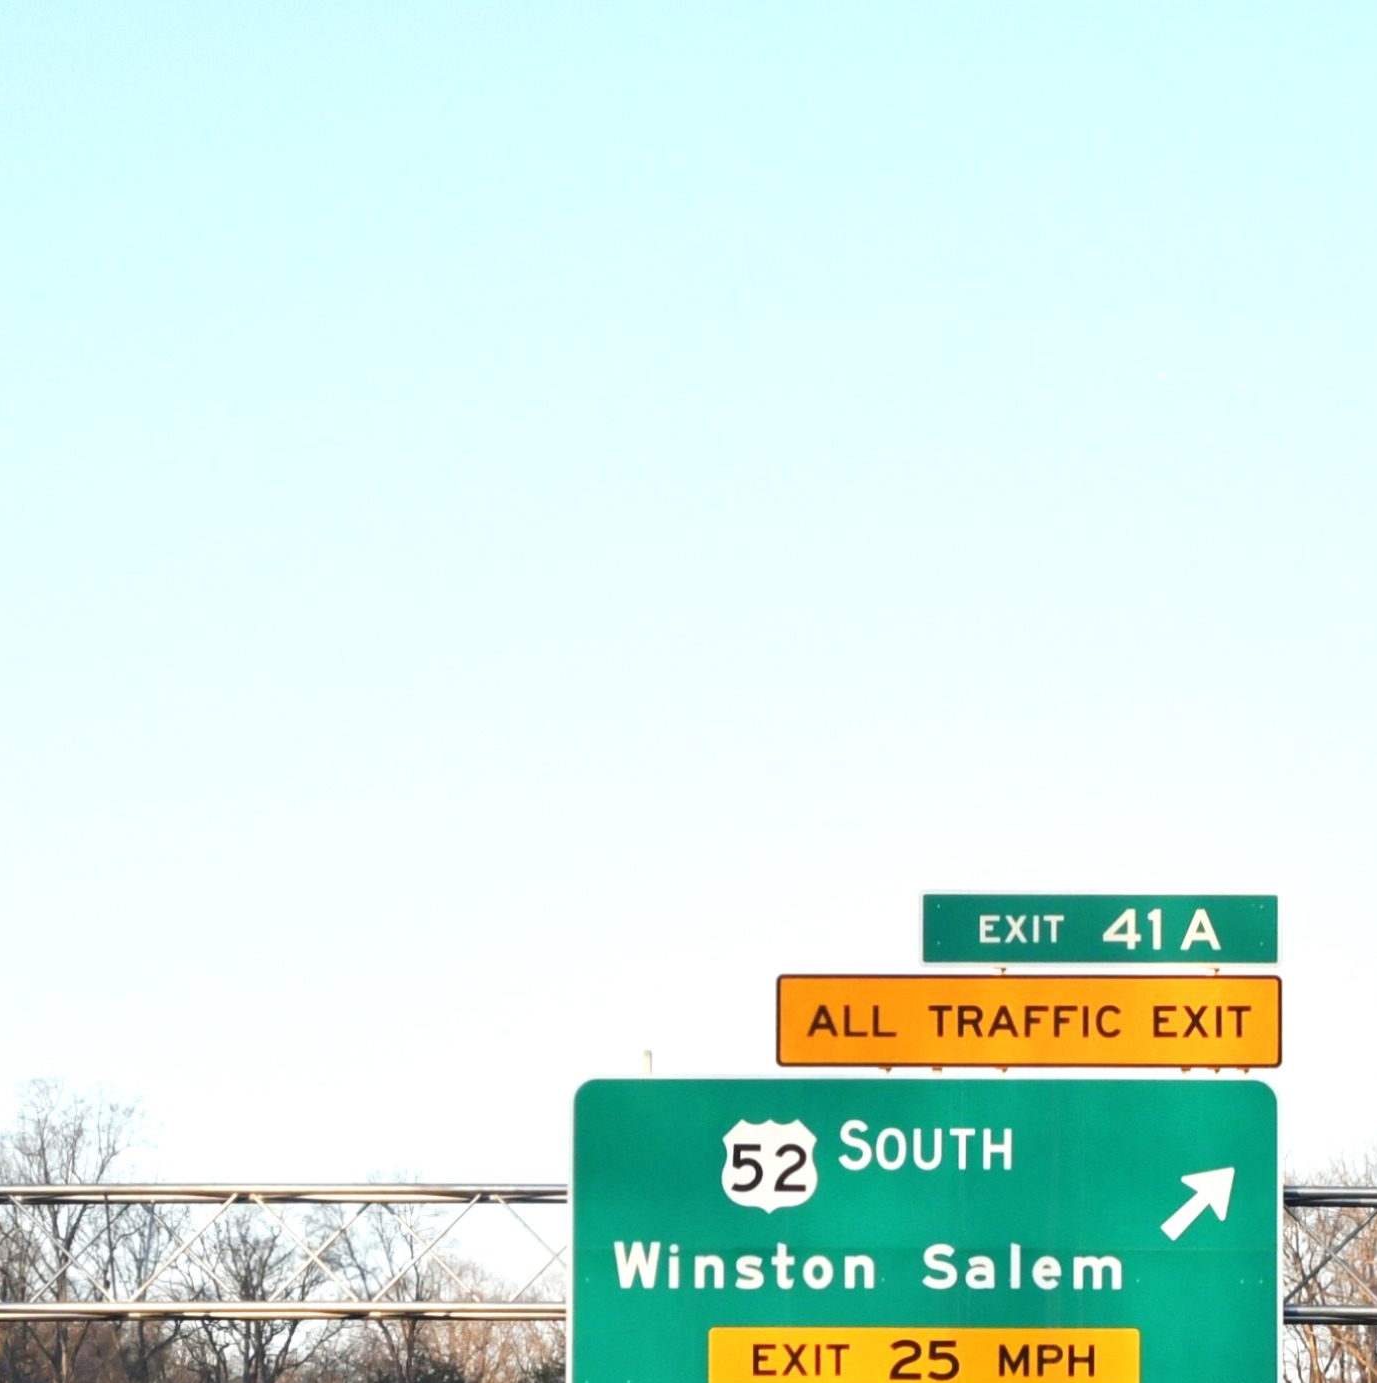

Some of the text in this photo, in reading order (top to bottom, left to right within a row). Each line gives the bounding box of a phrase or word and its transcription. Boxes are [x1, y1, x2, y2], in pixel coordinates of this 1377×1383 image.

[979, 914, 1065, 944] EXIT
[807, 1004, 1252, 1038] ALL TRAFFIC EXIT
[731, 1119, 1013, 1192] 52 SOUTH
[613, 1241, 1123, 1290] Winston Salem
[752, 1339, 1095, 1381] EXIT 25 MPH
